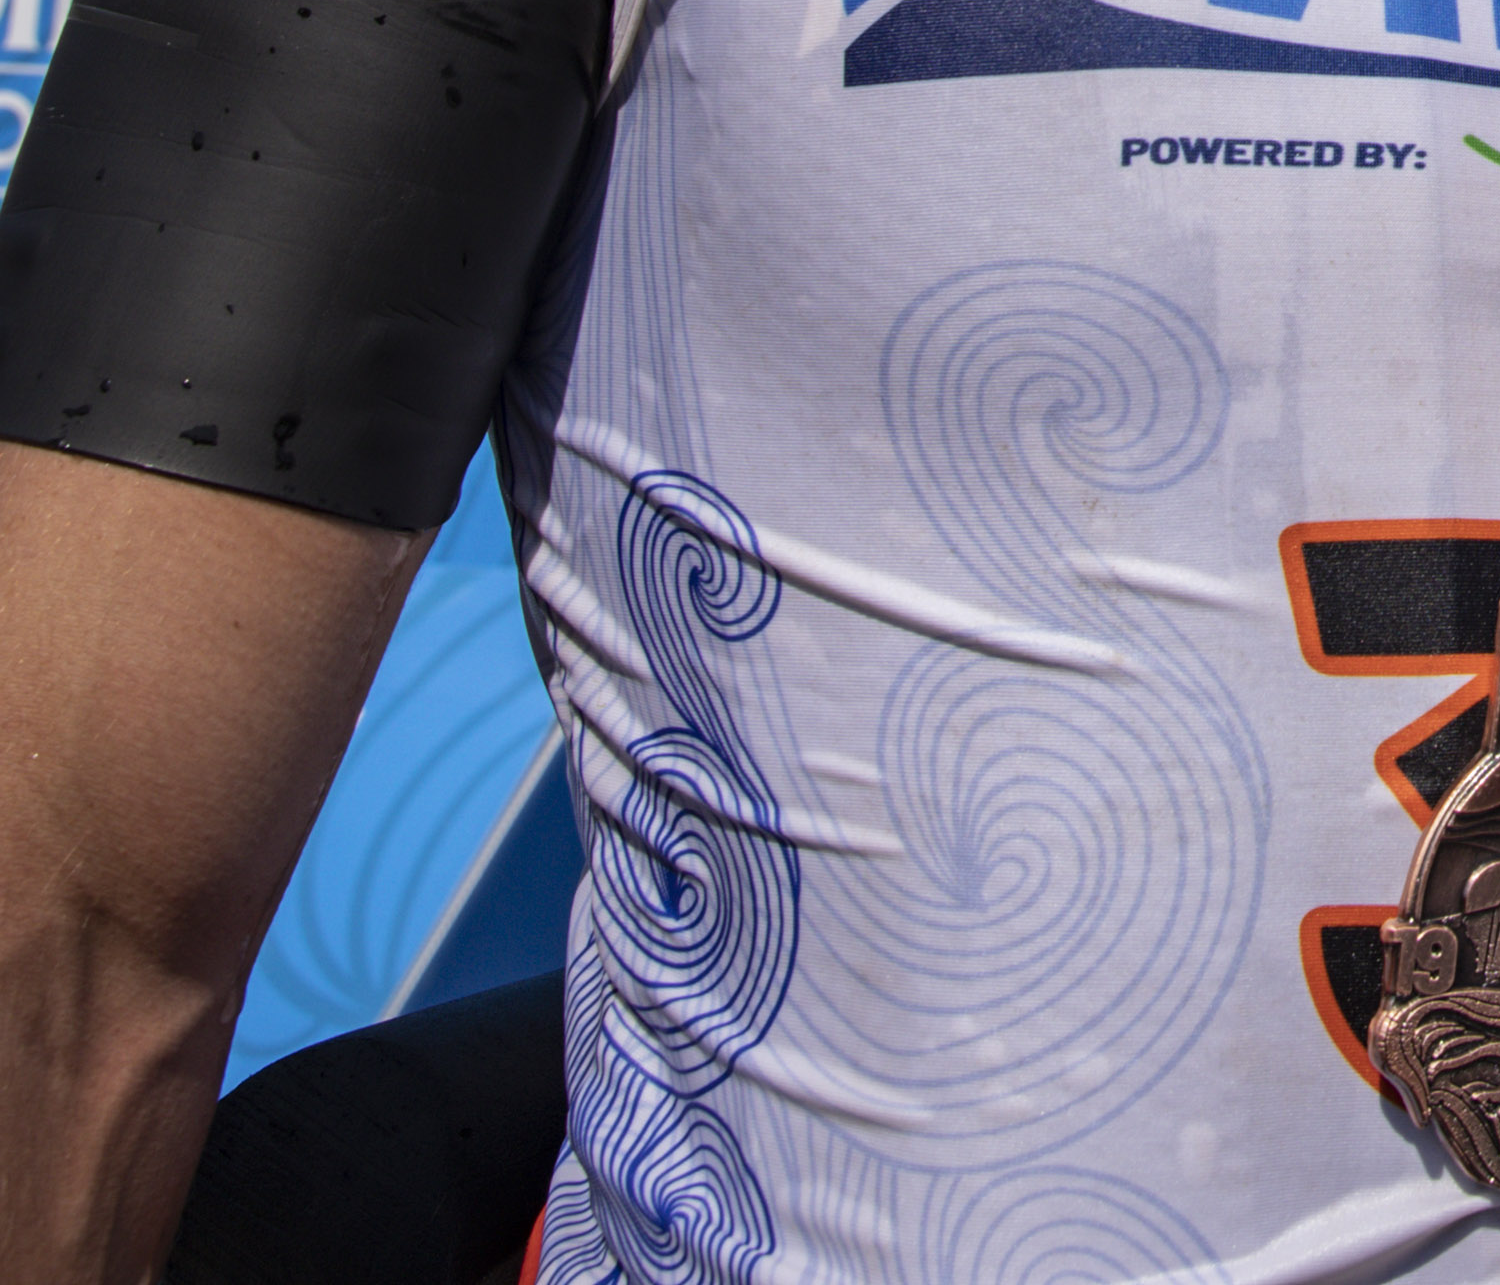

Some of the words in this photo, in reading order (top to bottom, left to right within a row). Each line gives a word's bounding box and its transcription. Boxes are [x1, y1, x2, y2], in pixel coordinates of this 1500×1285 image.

[1120, 136, 1343, 169] POWERED
[1355, 140, 1427, 170] BY:
[1381, 925, 1458, 997] 19
